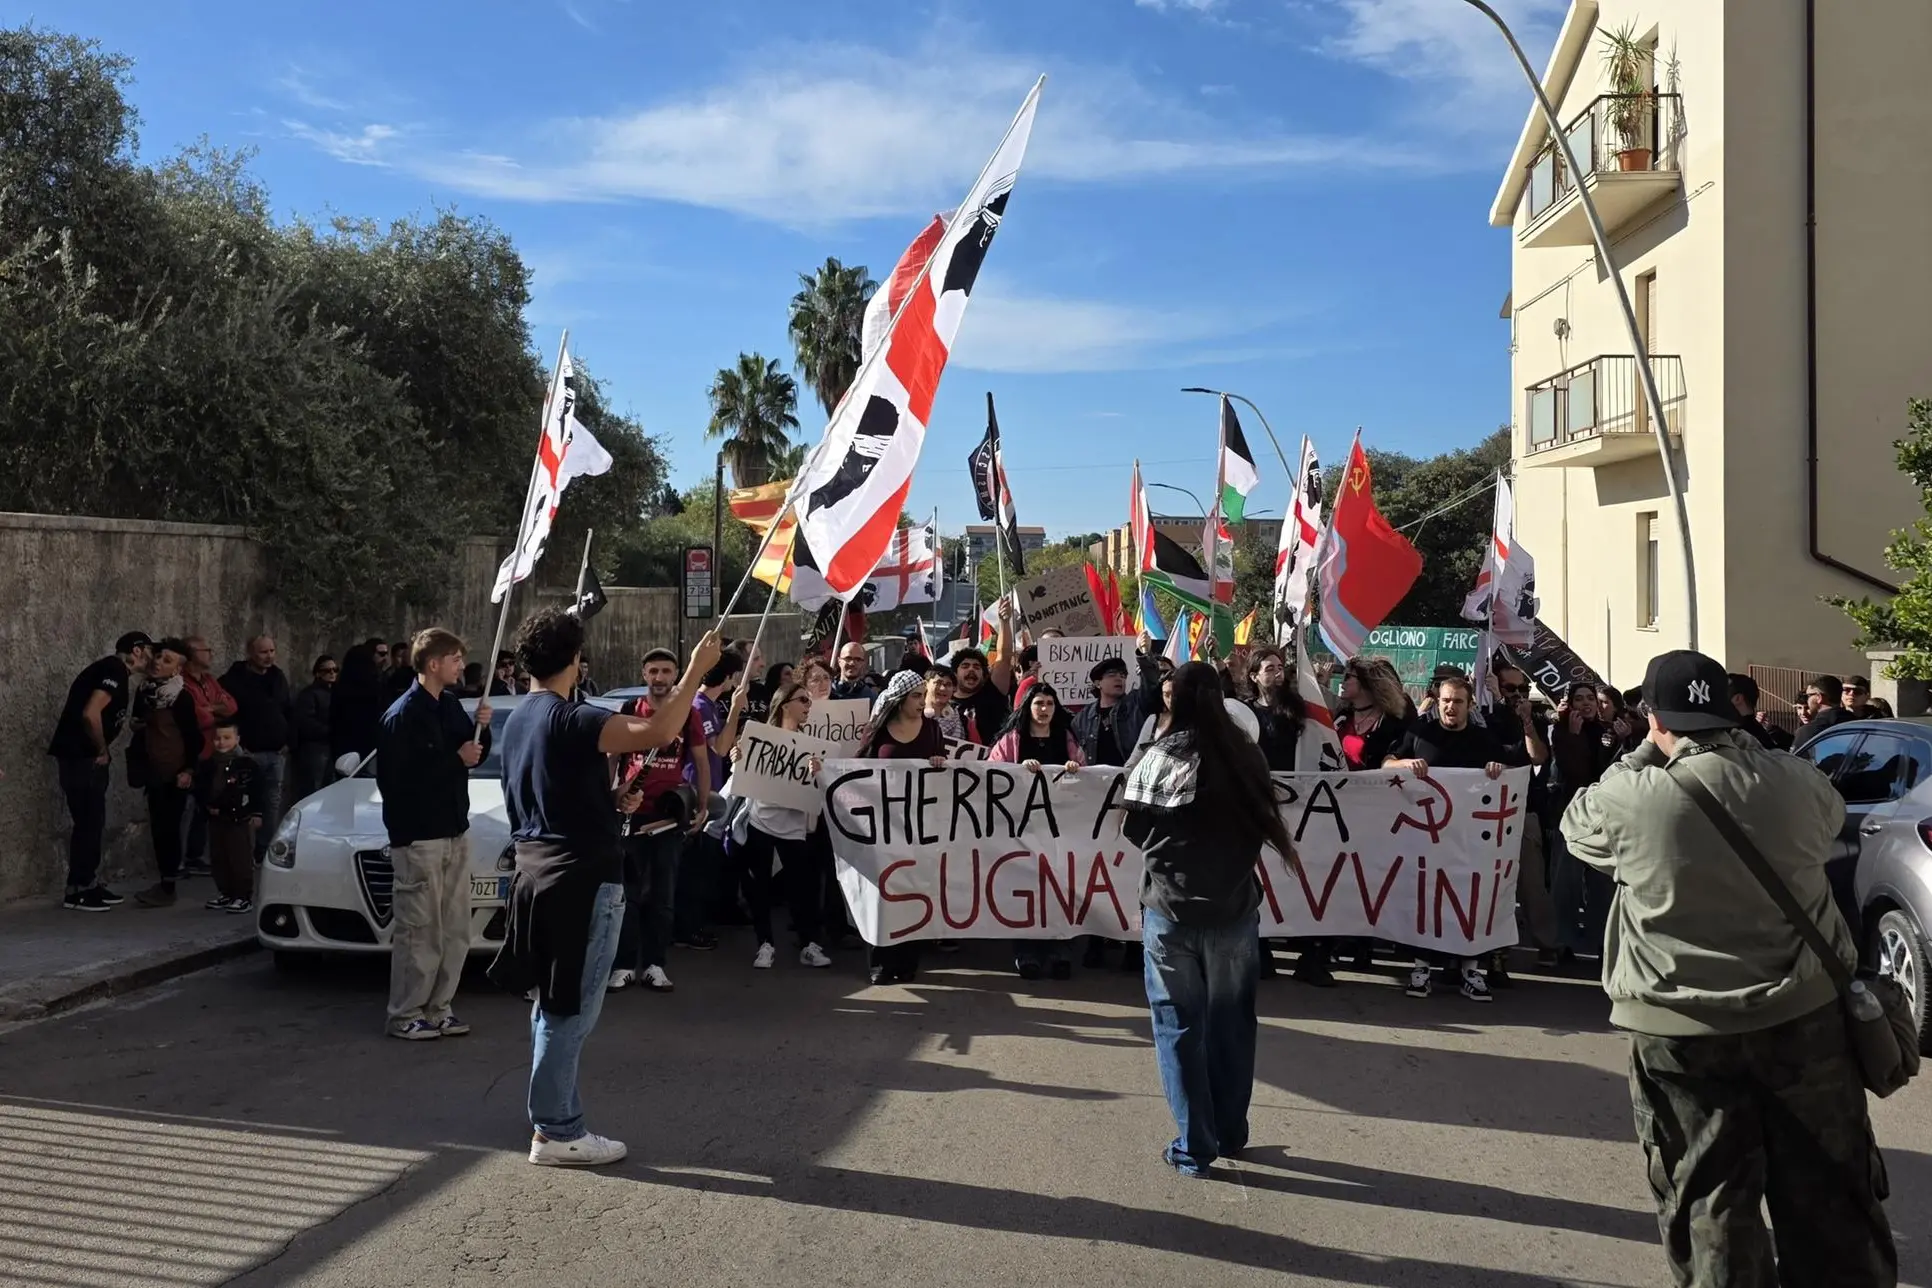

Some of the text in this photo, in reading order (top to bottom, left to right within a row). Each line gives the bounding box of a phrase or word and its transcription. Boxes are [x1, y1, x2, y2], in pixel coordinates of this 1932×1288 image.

[1027, 591, 1090, 624] DO NOT PANIC
[1369, 630, 1479, 650] OGLIONO FARC
[1049, 642, 1123, 662] BISMILLAH
[1687, 680, 1711, 704] NY
[1689, 742, 1718, 755] SONY
[470, 881, 498, 896] 70ZT
